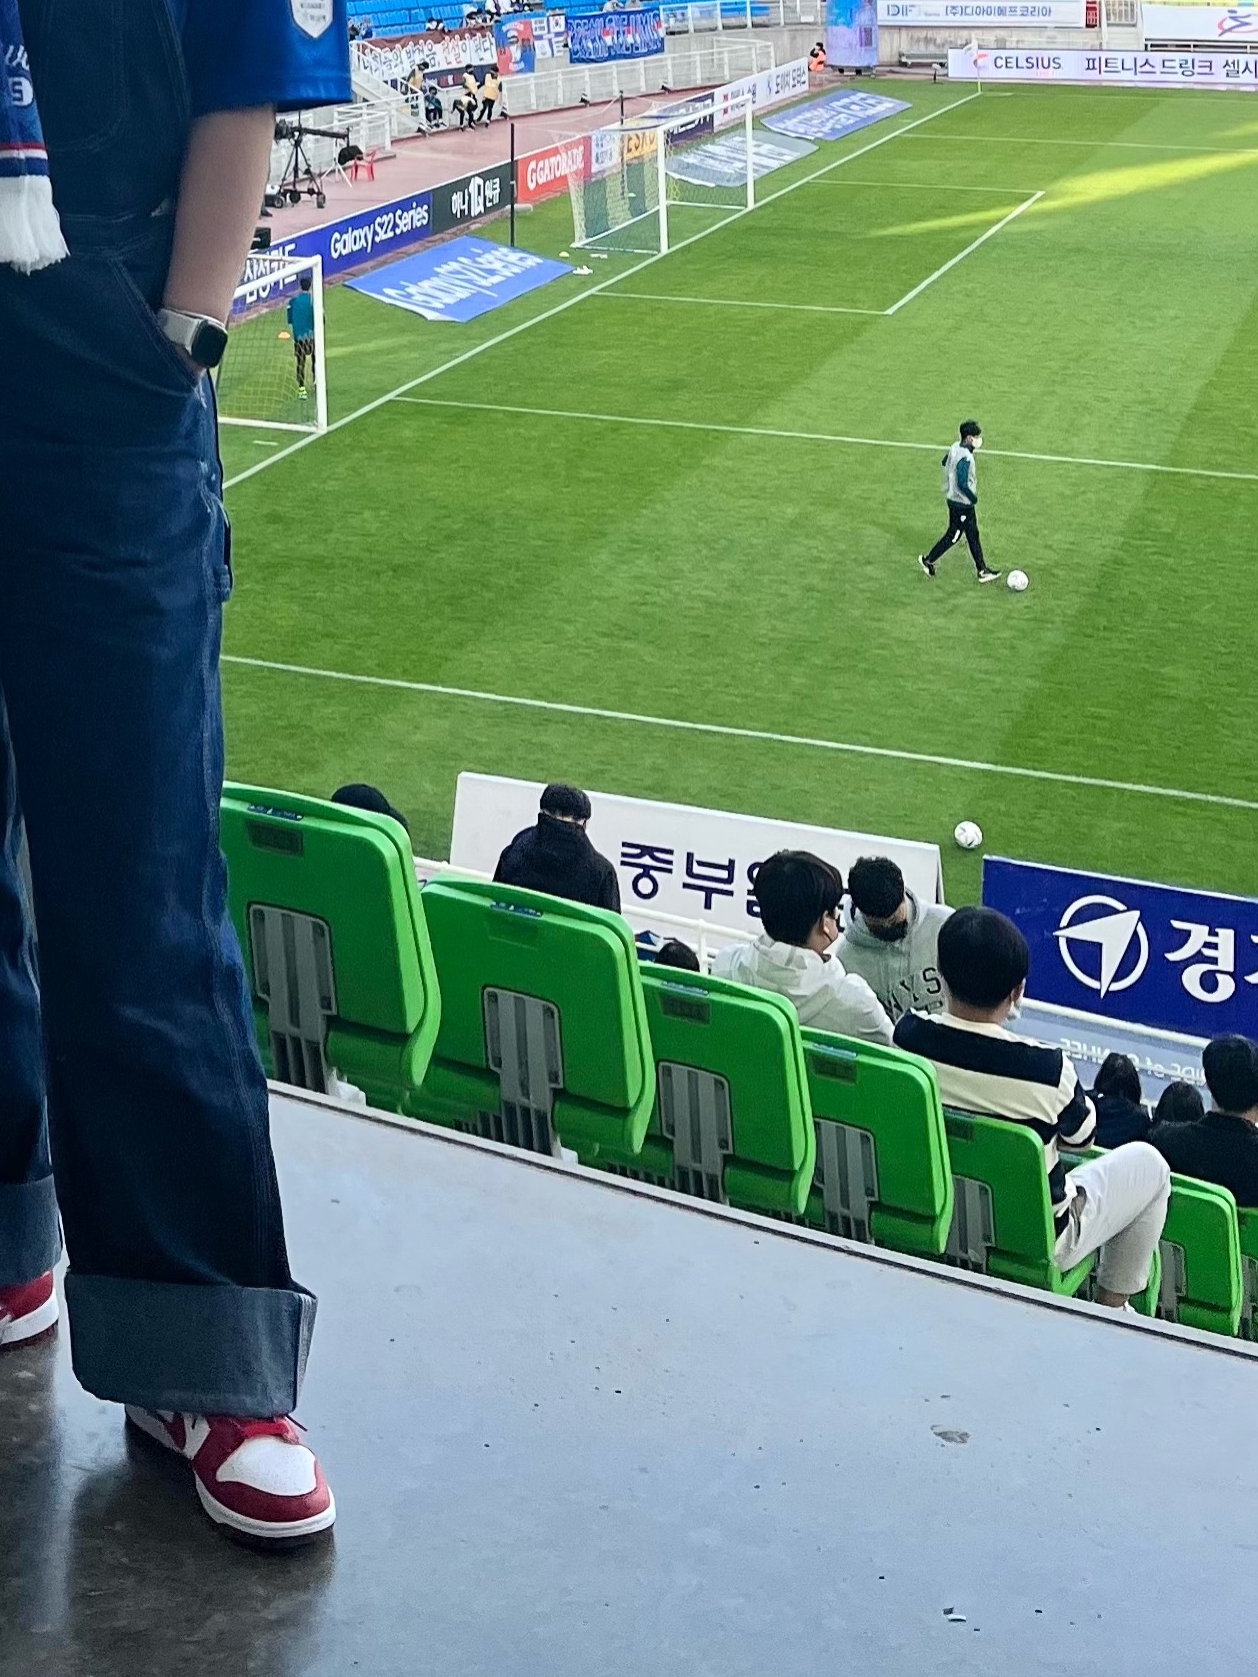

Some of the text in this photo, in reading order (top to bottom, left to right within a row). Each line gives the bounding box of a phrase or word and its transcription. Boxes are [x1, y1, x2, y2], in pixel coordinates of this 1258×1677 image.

[993, 55, 1063, 71] CELSIUS
[329, 203, 429, 260] Galaxy S22 Series
